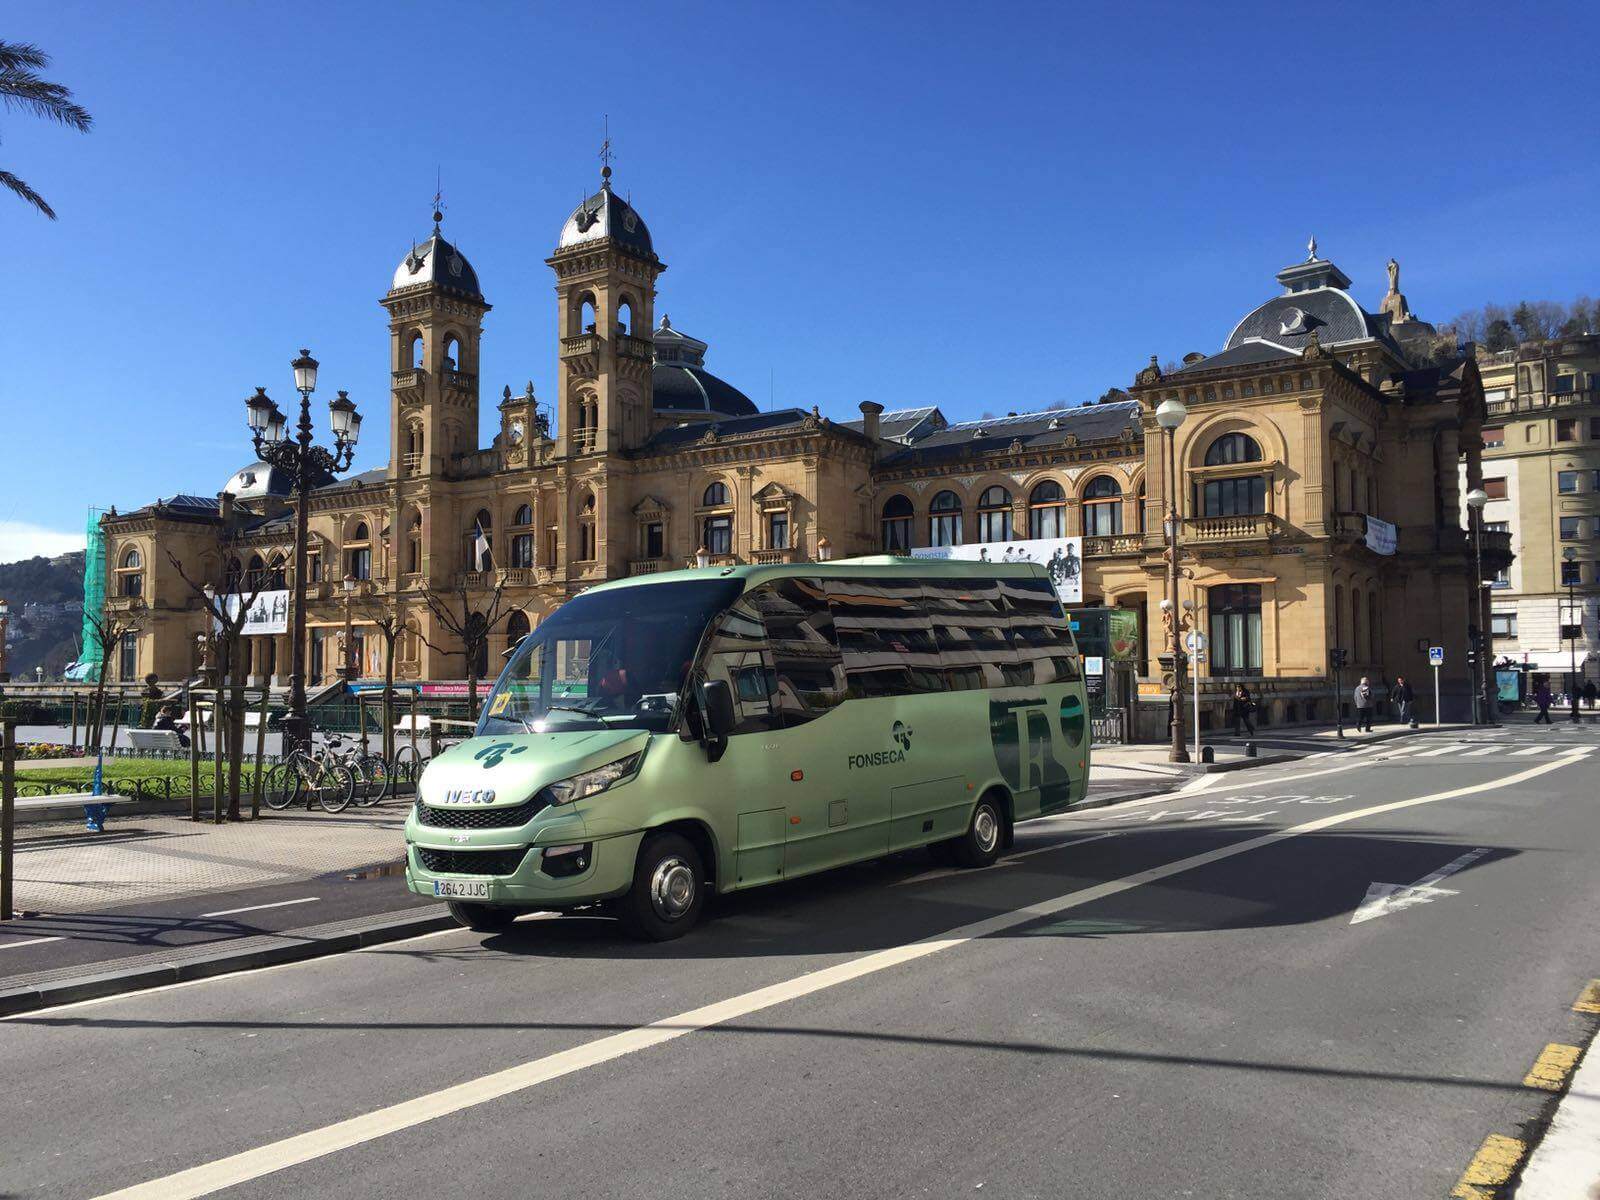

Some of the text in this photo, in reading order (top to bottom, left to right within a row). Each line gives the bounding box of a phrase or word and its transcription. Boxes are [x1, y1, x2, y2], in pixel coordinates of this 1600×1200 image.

[848, 749, 905, 770] FONSECA
[443, 789, 496, 804] IVECO
[440, 882, 486, 896] 2642 JJC
